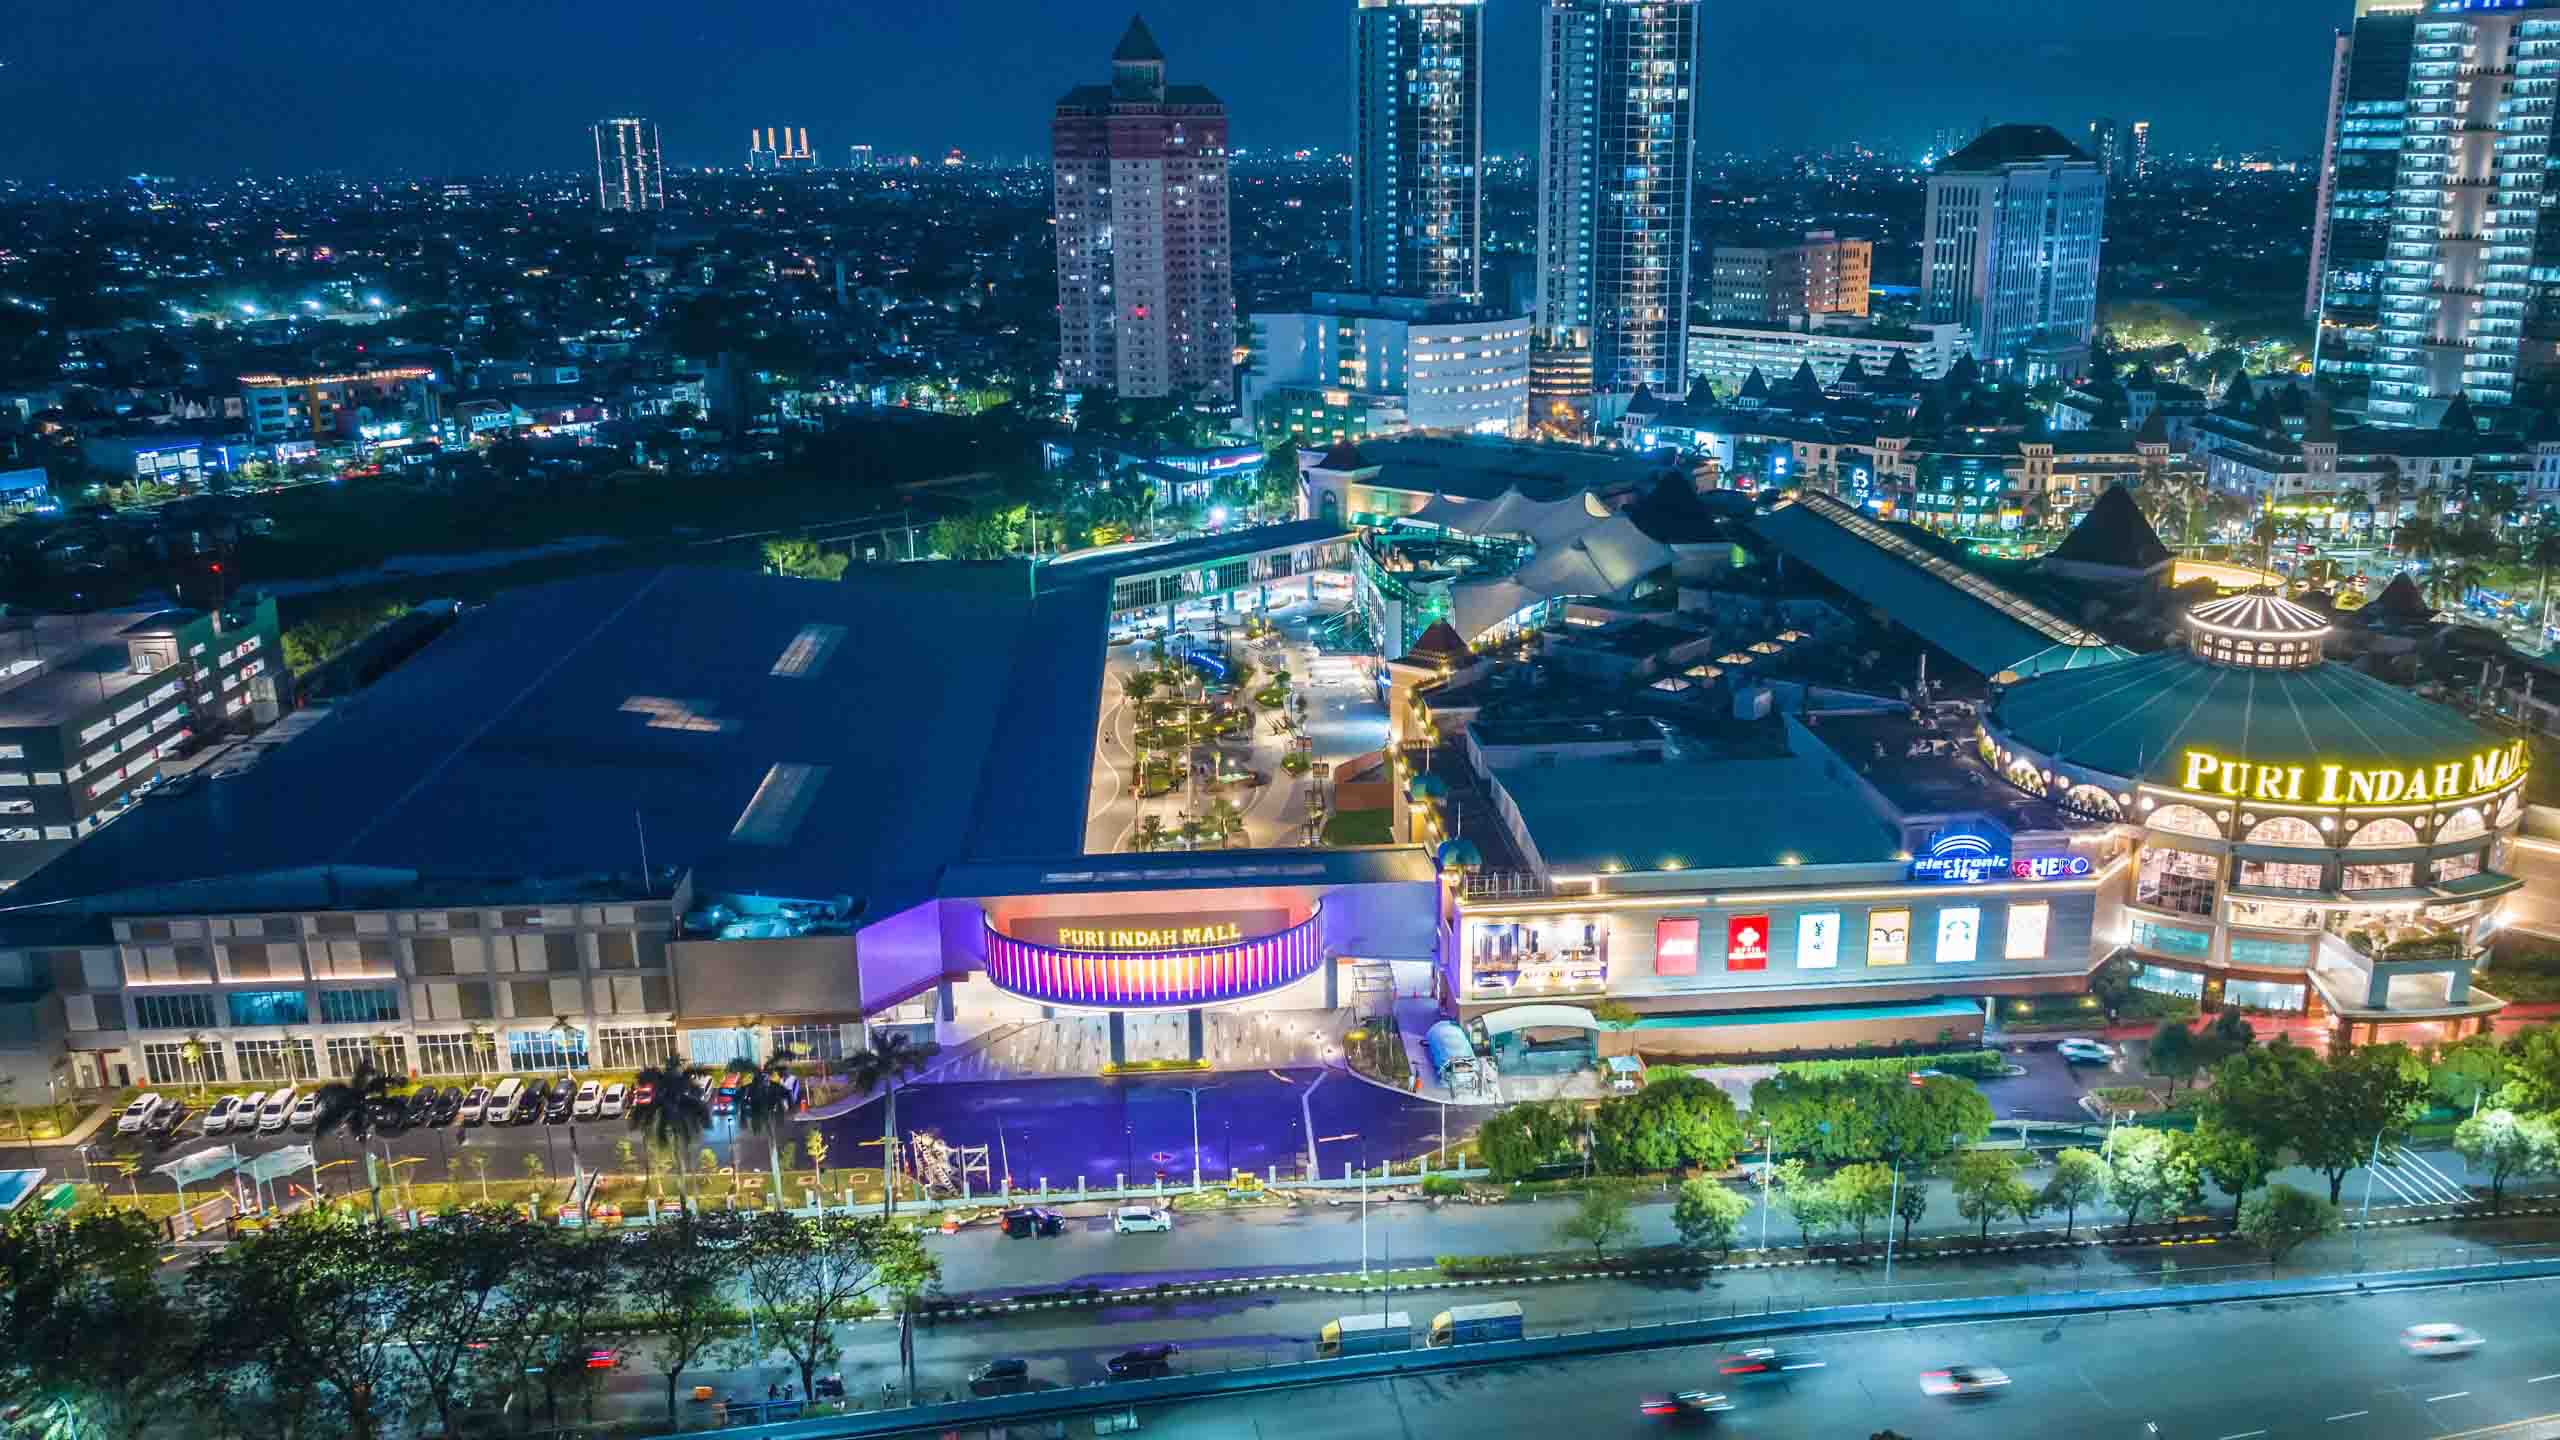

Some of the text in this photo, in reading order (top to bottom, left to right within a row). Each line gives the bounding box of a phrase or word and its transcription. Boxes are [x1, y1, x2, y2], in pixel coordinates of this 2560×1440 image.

[2183, 750, 2305, 800] PURI
[2317, 763, 2464, 803] INDAH
[1915, 855, 2009, 871] electronic
[2031, 856, 2089, 877] HERO
[1943, 866, 1980, 883] city
[1058, 922, 1242, 948] PURI INDAH MALL
